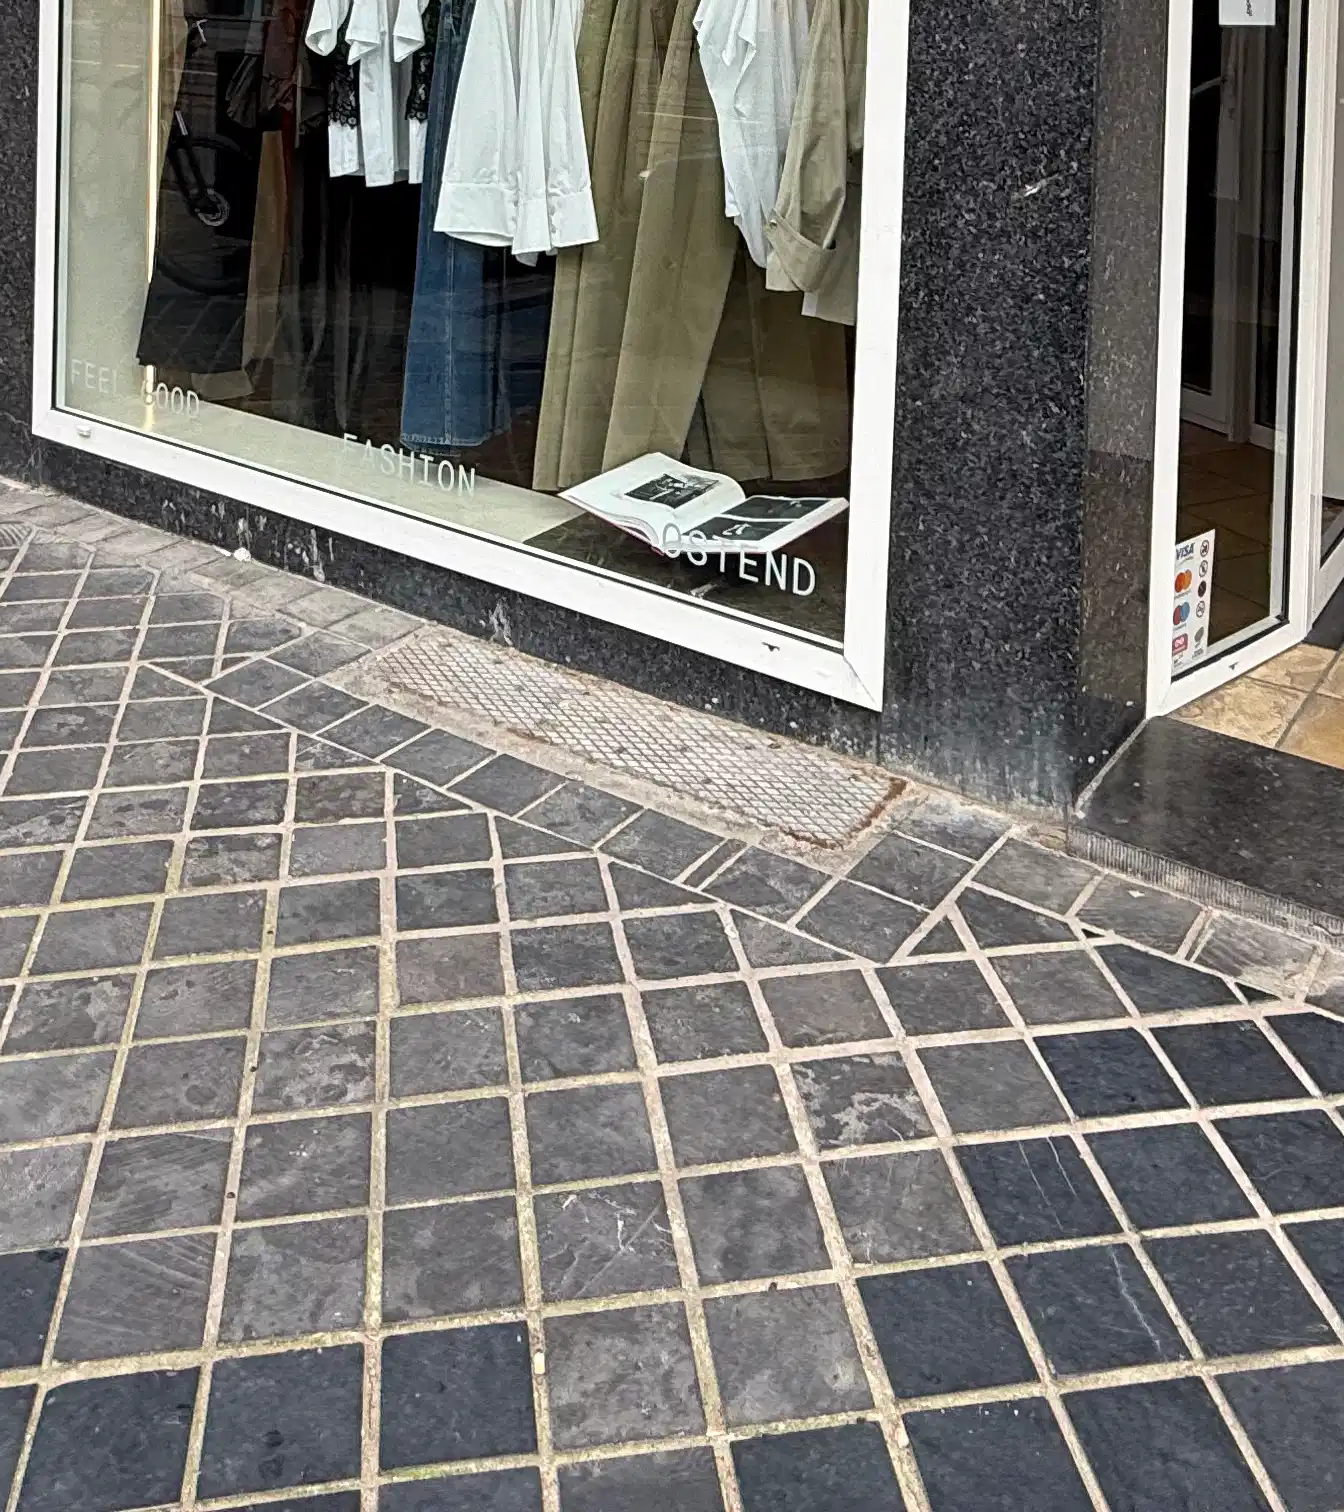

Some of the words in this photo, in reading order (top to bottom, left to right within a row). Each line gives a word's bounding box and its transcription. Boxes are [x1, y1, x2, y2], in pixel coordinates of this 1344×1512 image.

[342, 433, 476, 499] FASHION
[662, 523, 816, 596] OSTEND
[1176, 542, 1196, 560] VISA
